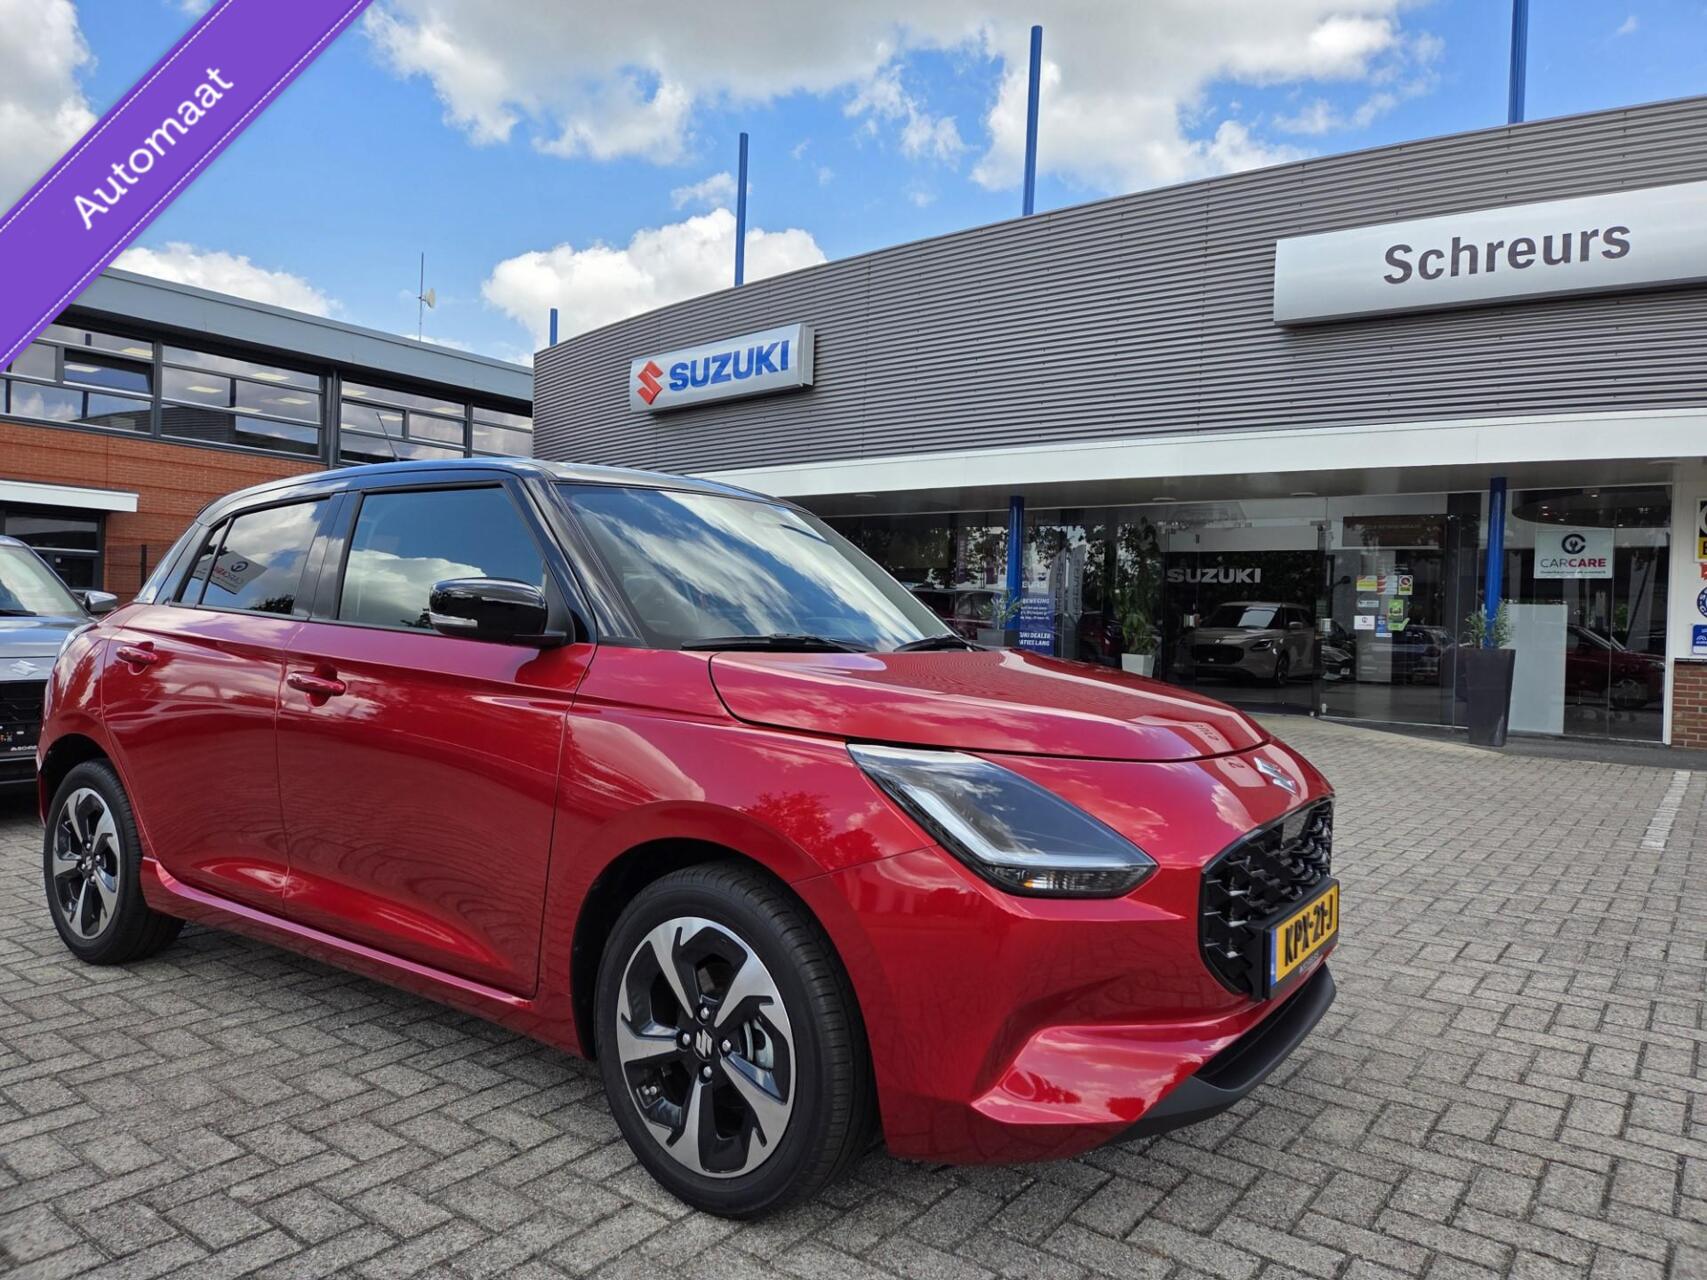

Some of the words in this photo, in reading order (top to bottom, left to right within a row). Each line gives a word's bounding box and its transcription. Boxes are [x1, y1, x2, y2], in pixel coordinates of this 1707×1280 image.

[1383, 225, 1631, 285] Schreurs
[669, 340, 790, 391] SUZUKI
[1167, 568, 1262, 584] SUZUKI
[1540, 558, 1607, 568] CARCARE
